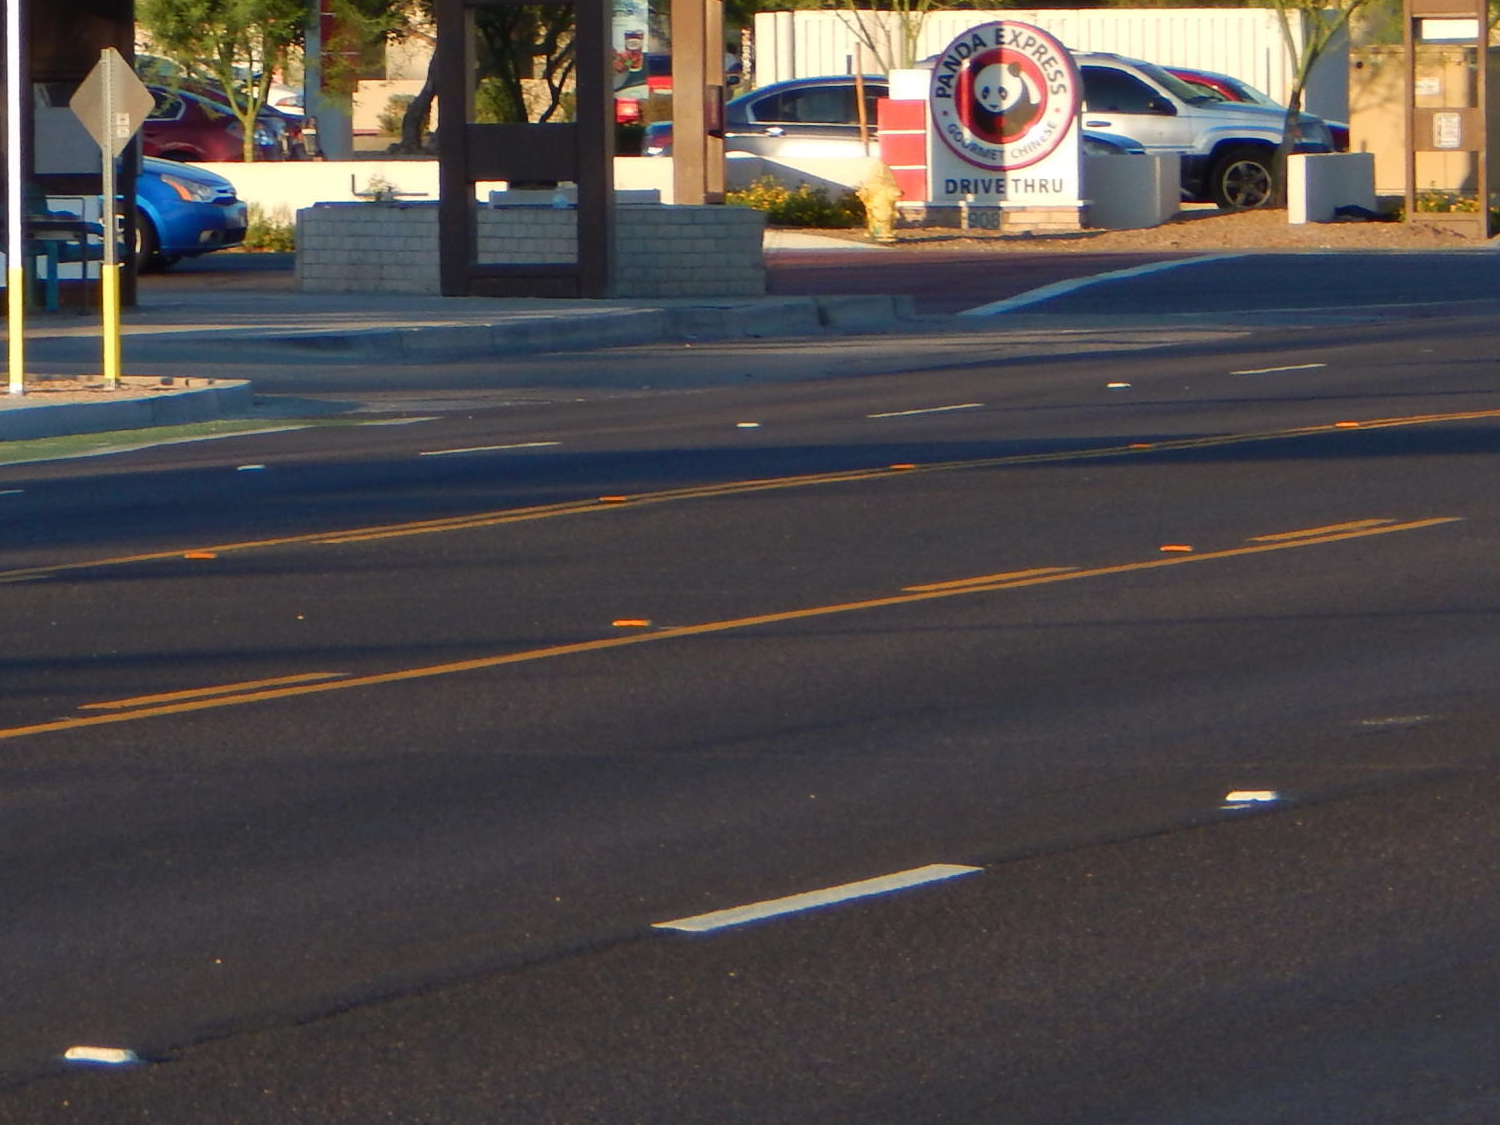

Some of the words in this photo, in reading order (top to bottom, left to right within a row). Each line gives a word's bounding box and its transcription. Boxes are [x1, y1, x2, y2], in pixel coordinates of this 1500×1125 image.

[935, 33, 987, 98] PANDA
[994, 27, 1067, 96] EXPRESS
[947, 122, 1005, 161] GOURMET
[1010, 121, 1056, 160] CHINESE
[944, 177, 1006, 195] DRIVE
[1011, 177, 1064, 194] THRU
